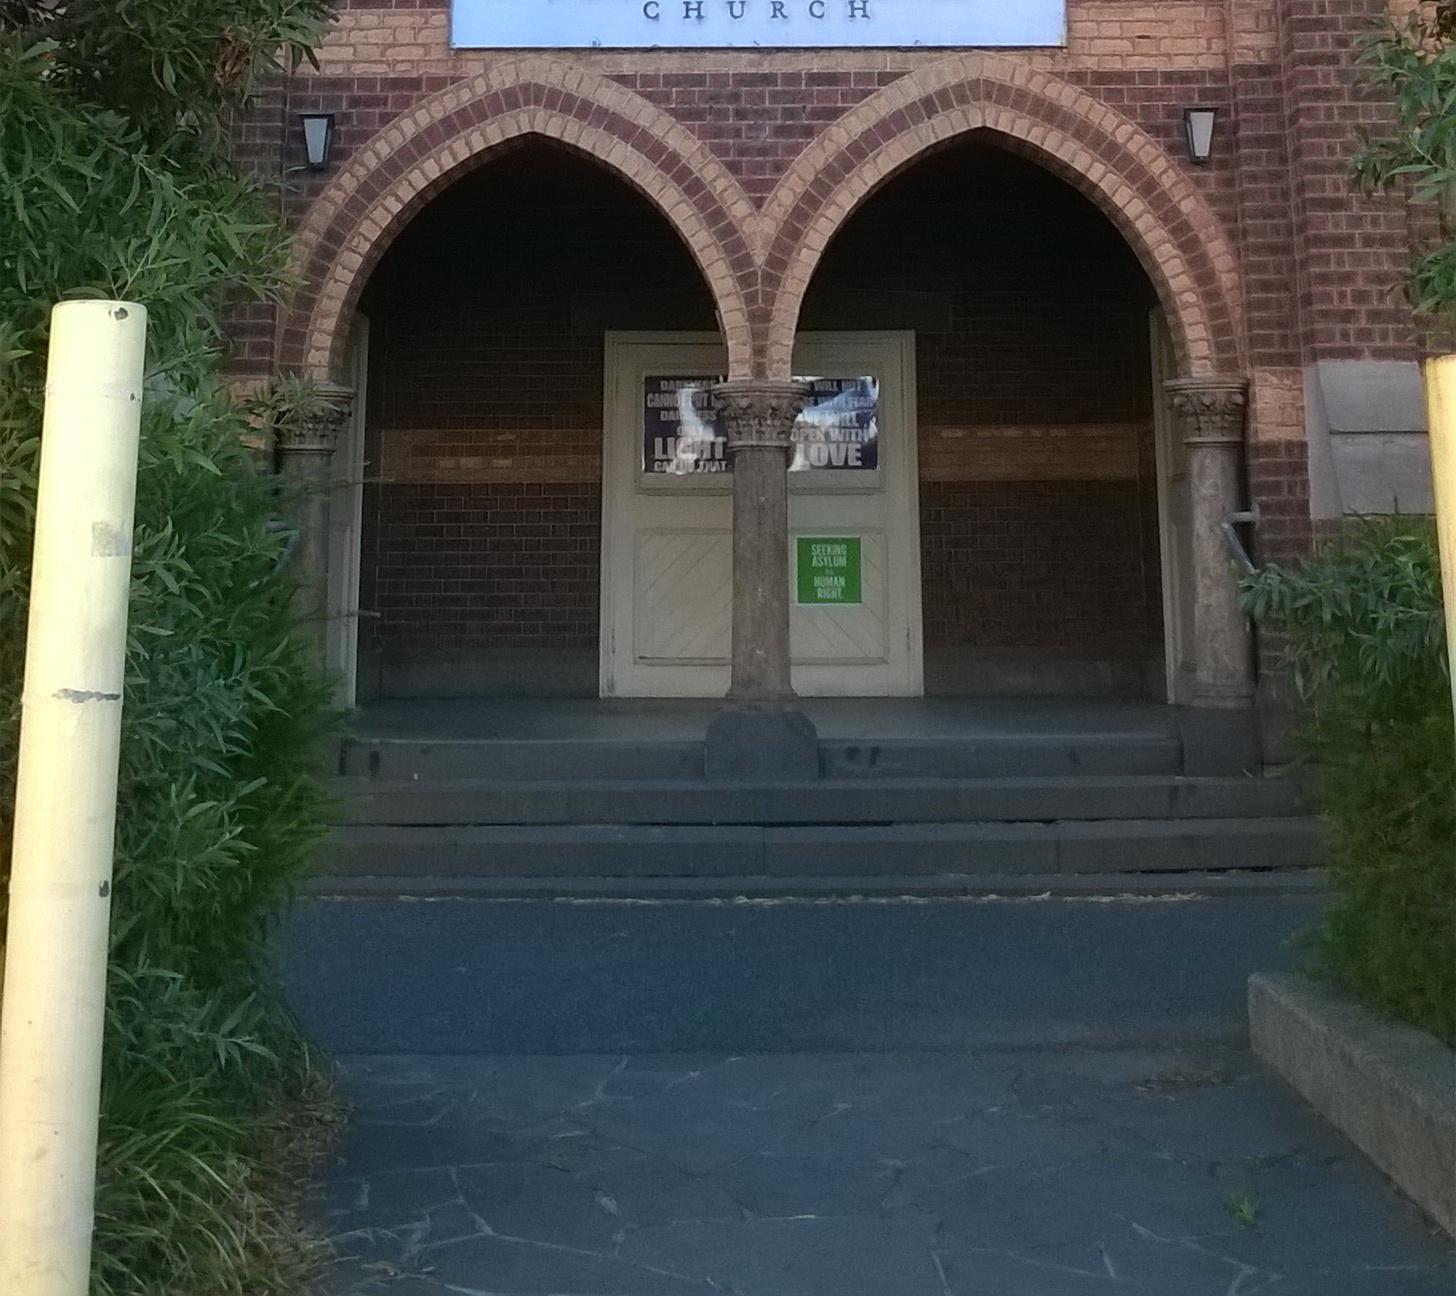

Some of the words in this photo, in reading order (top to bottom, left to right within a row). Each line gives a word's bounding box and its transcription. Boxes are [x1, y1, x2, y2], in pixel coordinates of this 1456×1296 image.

[644, 0, 872, 20] CHURCH
[654, 437, 727, 459] LIGHT
[795, 443, 862, 466] LOVE
[811, 544, 848, 556] SEEKING
[811, 556, 847, 567] ASYLUM
[813, 576, 846, 587] HUMAN
